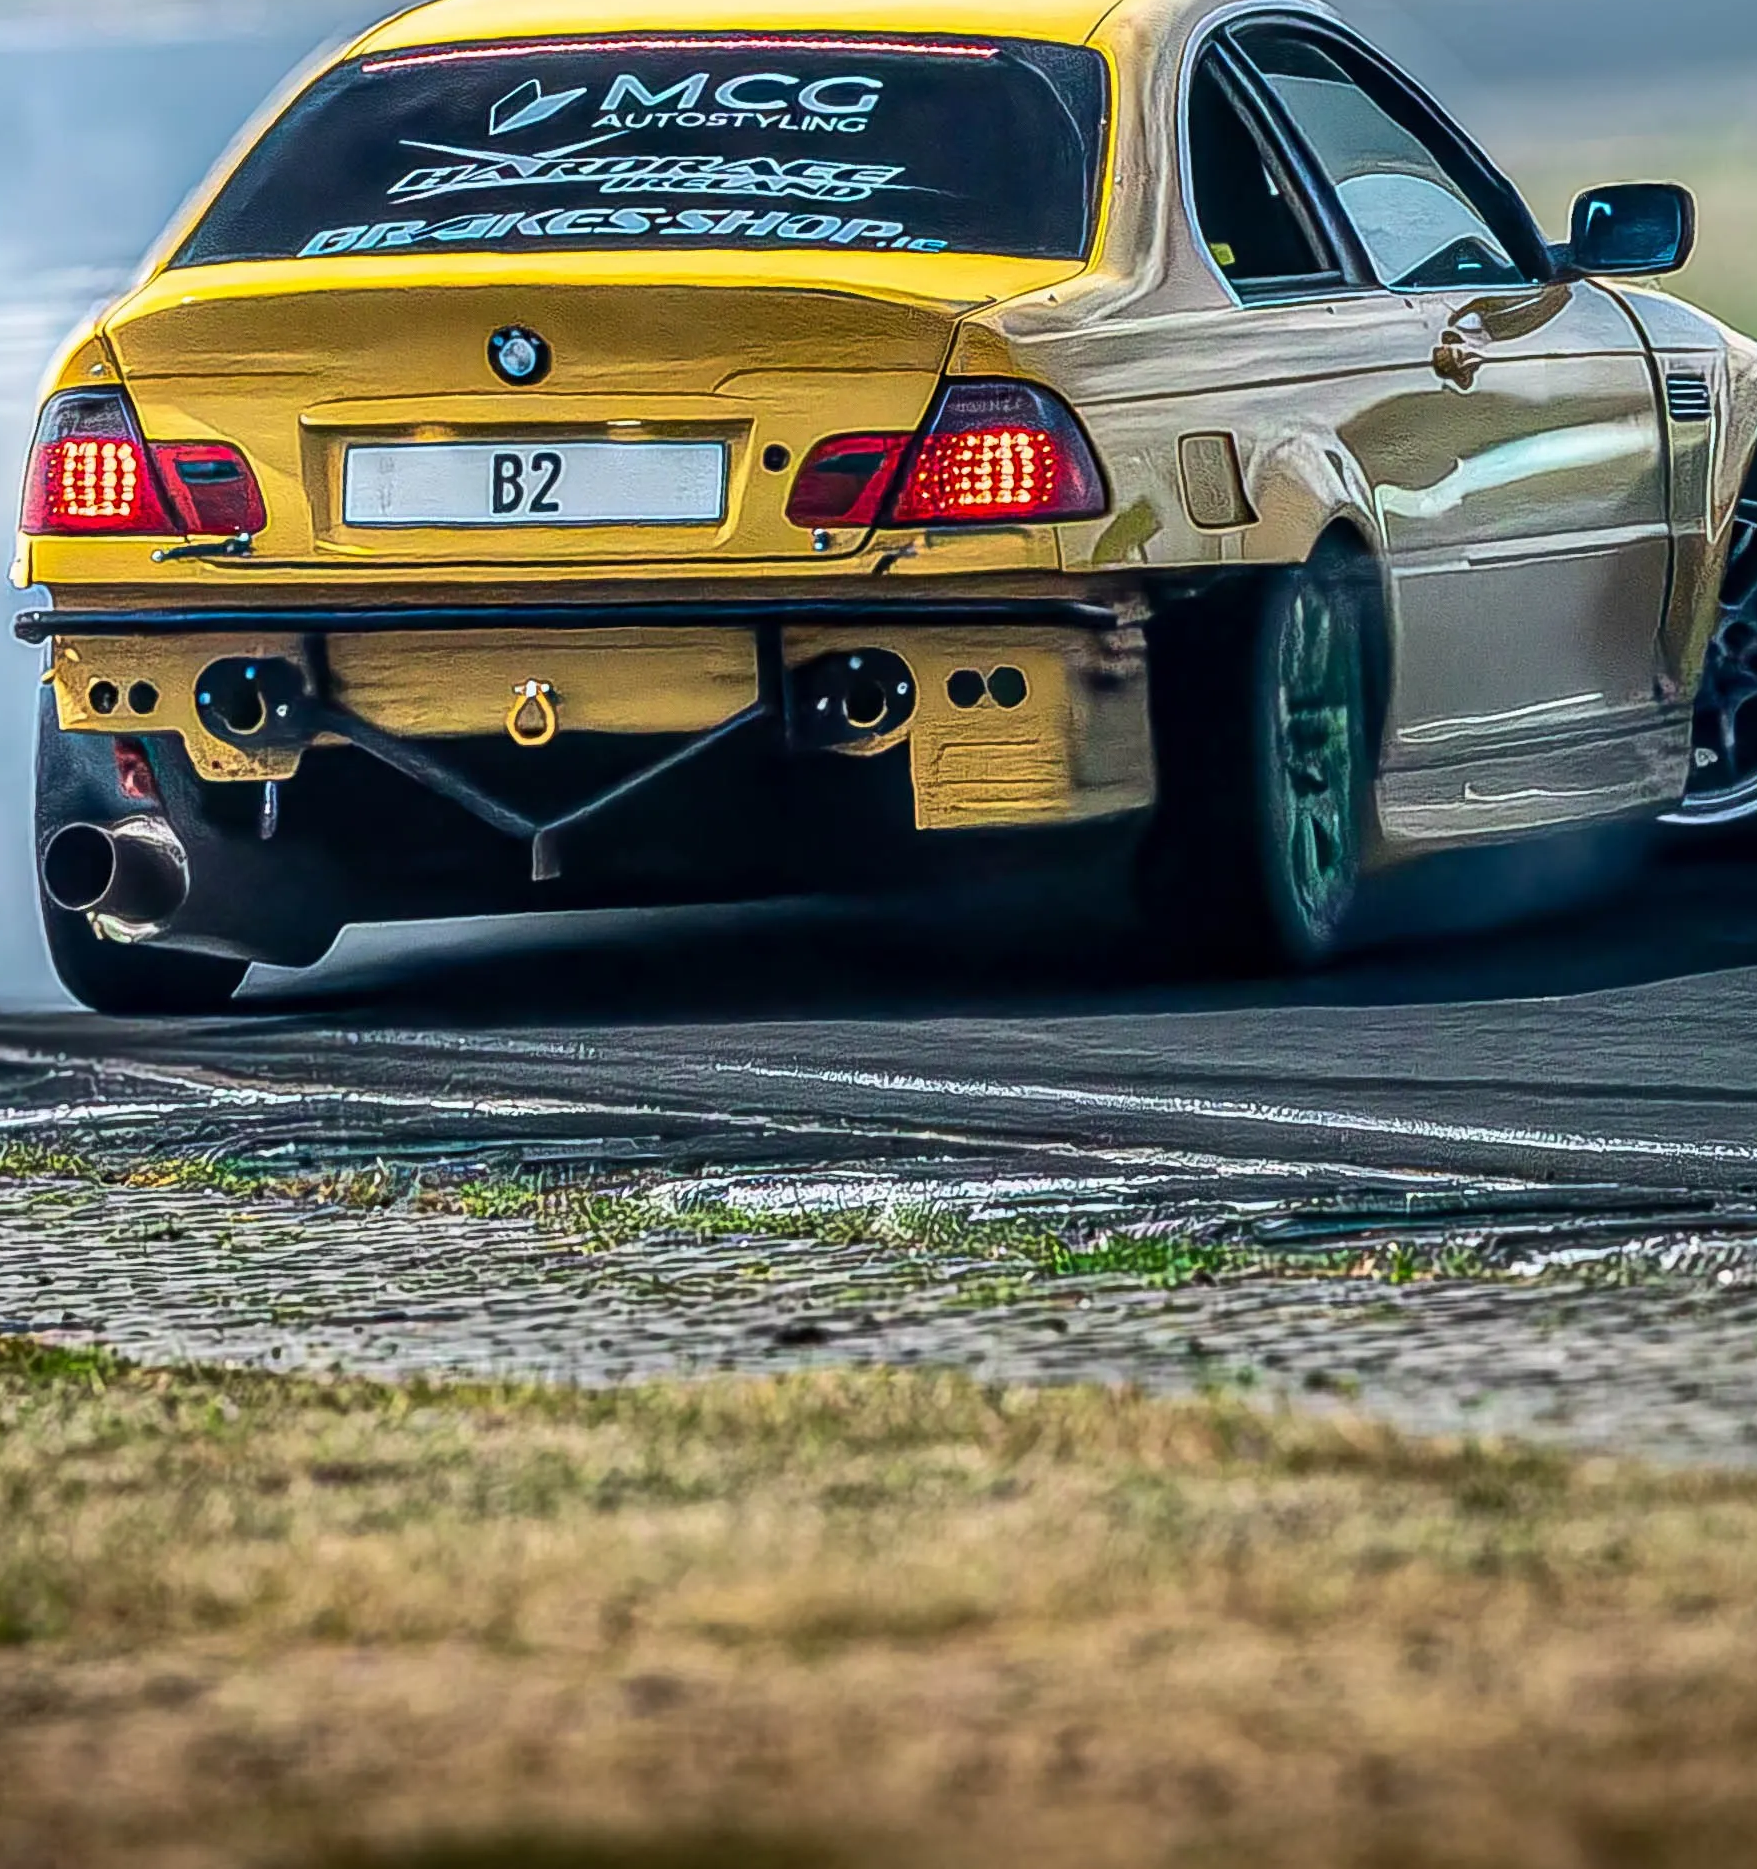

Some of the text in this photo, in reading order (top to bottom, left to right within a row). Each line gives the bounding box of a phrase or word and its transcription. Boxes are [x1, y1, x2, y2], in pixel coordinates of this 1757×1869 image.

[599, 73, 884, 114] MCG
[591, 112, 869, 133] AUTOSTYLING
[387, 152, 907, 197] HARDRACE
[598, 174, 875, 202] IRELAND
[491, 452, 563, 514] B2
